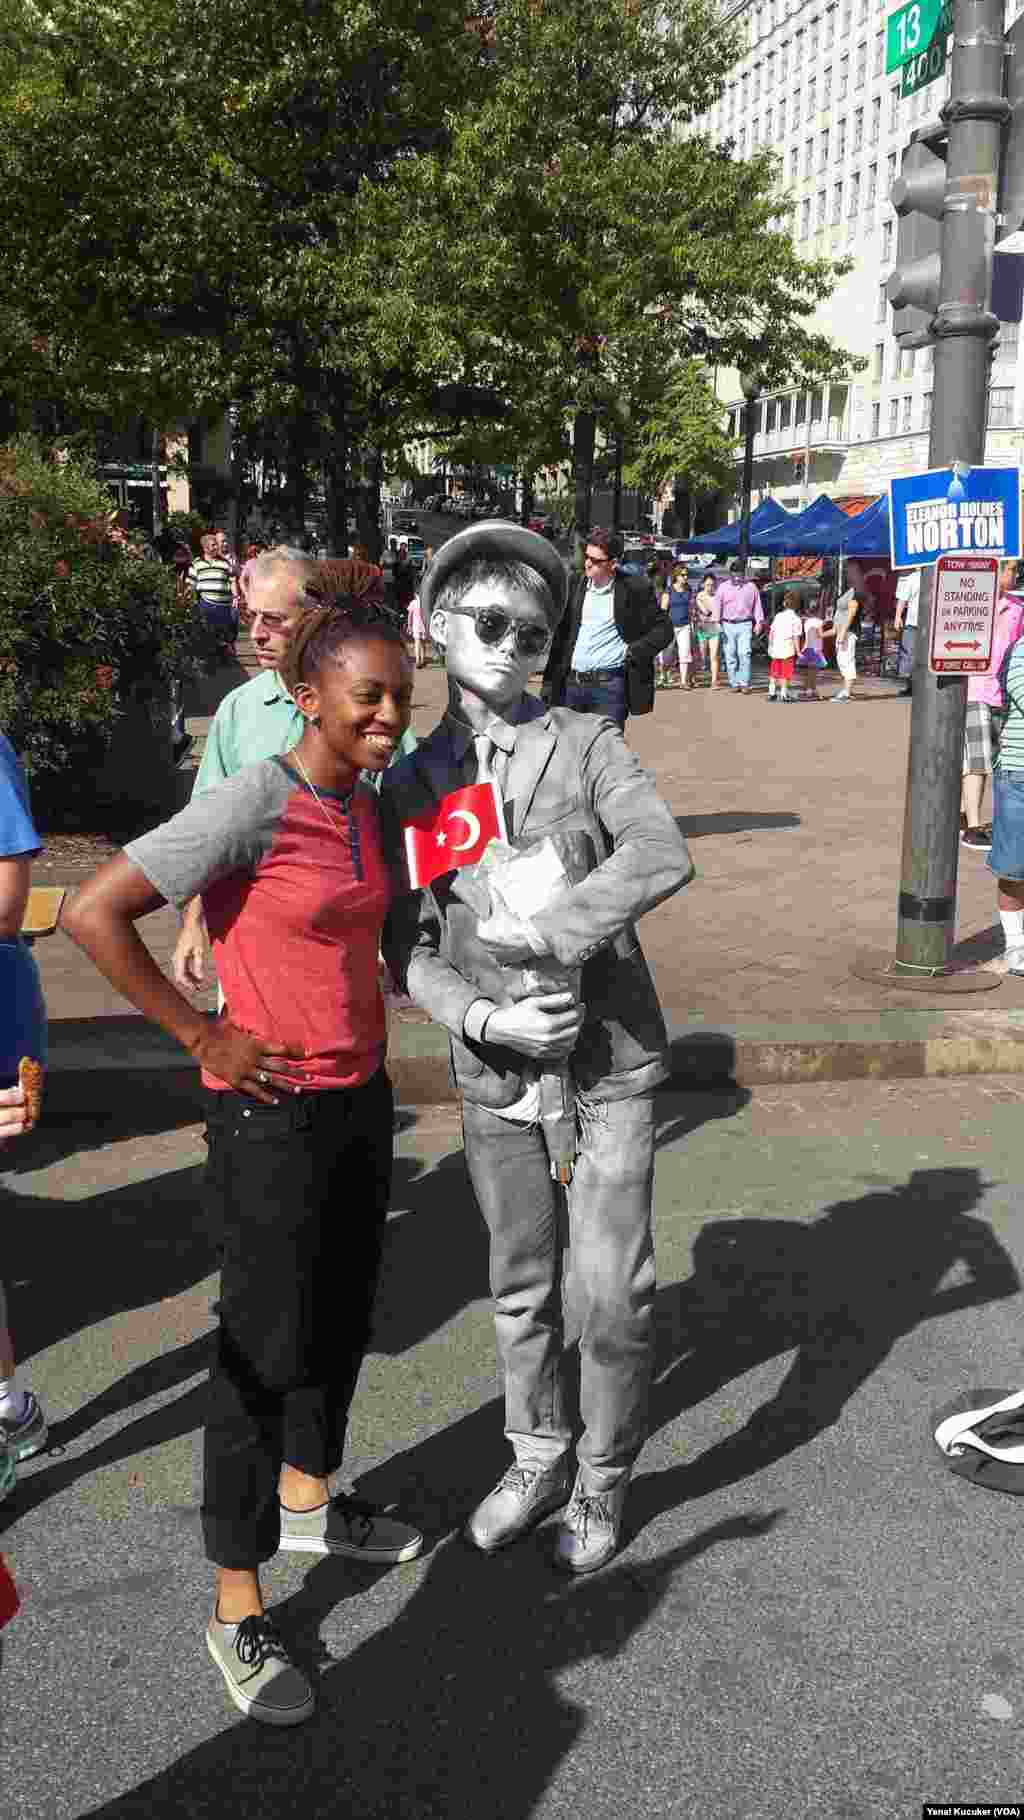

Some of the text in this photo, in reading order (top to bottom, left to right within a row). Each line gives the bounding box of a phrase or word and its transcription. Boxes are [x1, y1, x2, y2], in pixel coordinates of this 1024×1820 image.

[896, 4, 920, 55] 13
[906, 516, 1004, 555] NORTON
[959, 577, 976, 588] NO
[943, 591, 990, 601] STANDING
[952, 606, 989, 617] PARKING
[943, 621, 985, 632] ANYTIME
